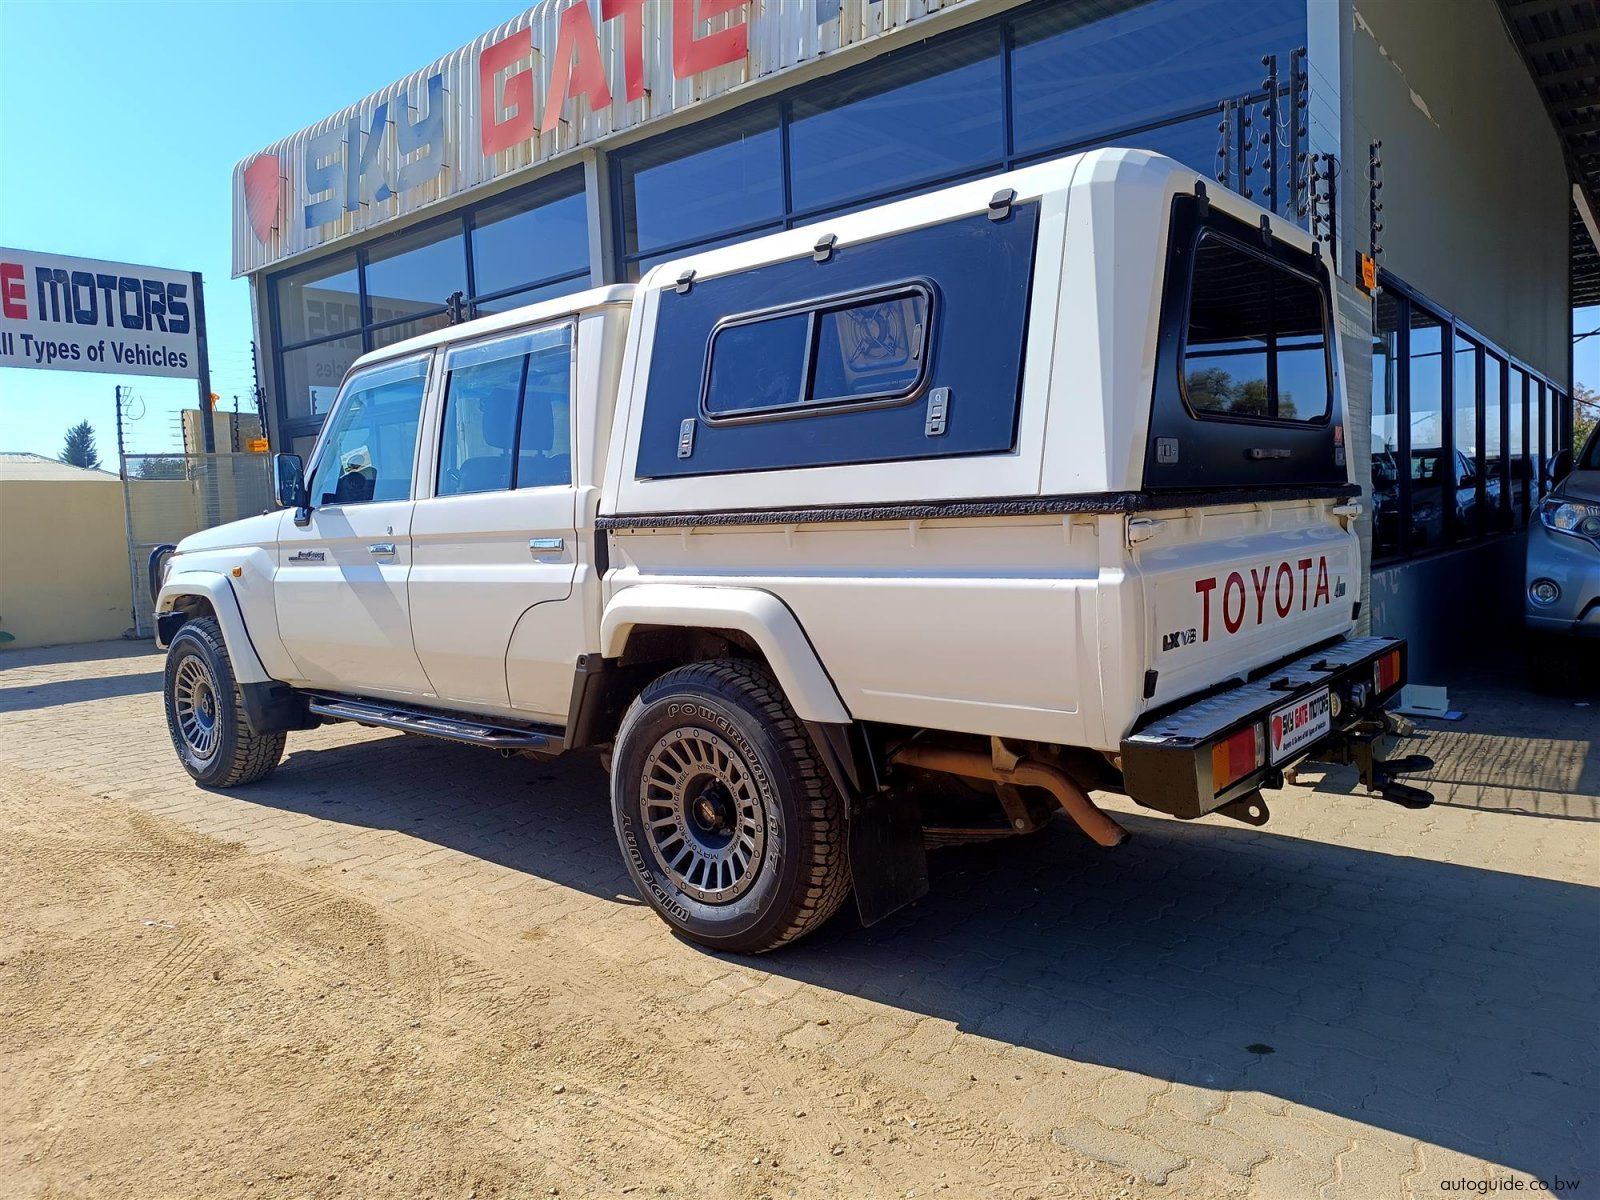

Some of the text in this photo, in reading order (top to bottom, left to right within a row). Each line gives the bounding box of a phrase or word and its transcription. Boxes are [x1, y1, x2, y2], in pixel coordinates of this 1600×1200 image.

[305, 0, 749, 229] SKY GATE
[35, 266, 190, 334] MOTORS
[20, 333, 81, 364] Types
[87, 340, 105, 362] of
[111, 341, 188, 368] Vehicles
[1195, 556, 1330, 642] TOYOTA
[1163, 631, 1180, 651] LX
[1295, 703, 1308, 729] GATE
